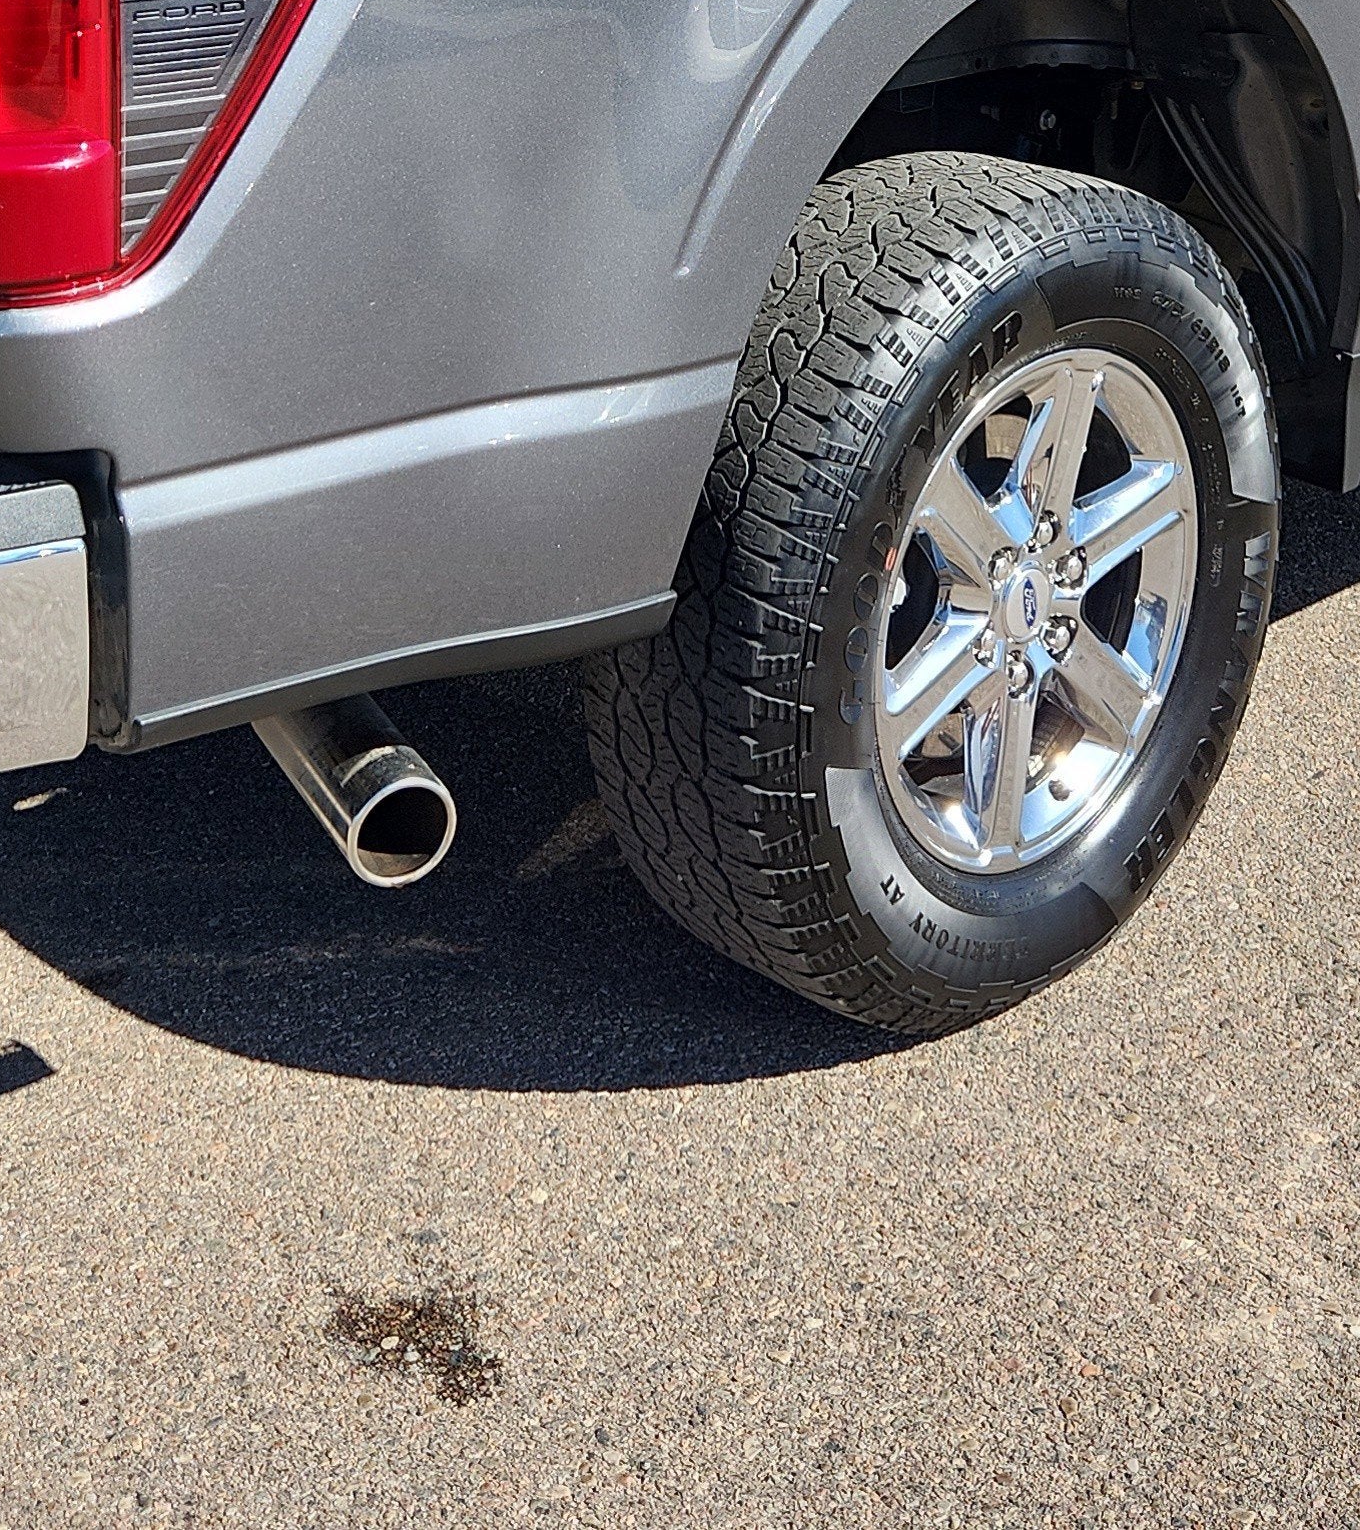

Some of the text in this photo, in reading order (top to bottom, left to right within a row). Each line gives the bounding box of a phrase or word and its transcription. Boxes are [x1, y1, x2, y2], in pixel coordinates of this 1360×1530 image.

[132, 0, 246, 24] FORD
[1122, 530, 1272, 896] WRANGLER
[879, 873, 906, 906] AT
[908, 911, 1029, 963] TERRITORY
